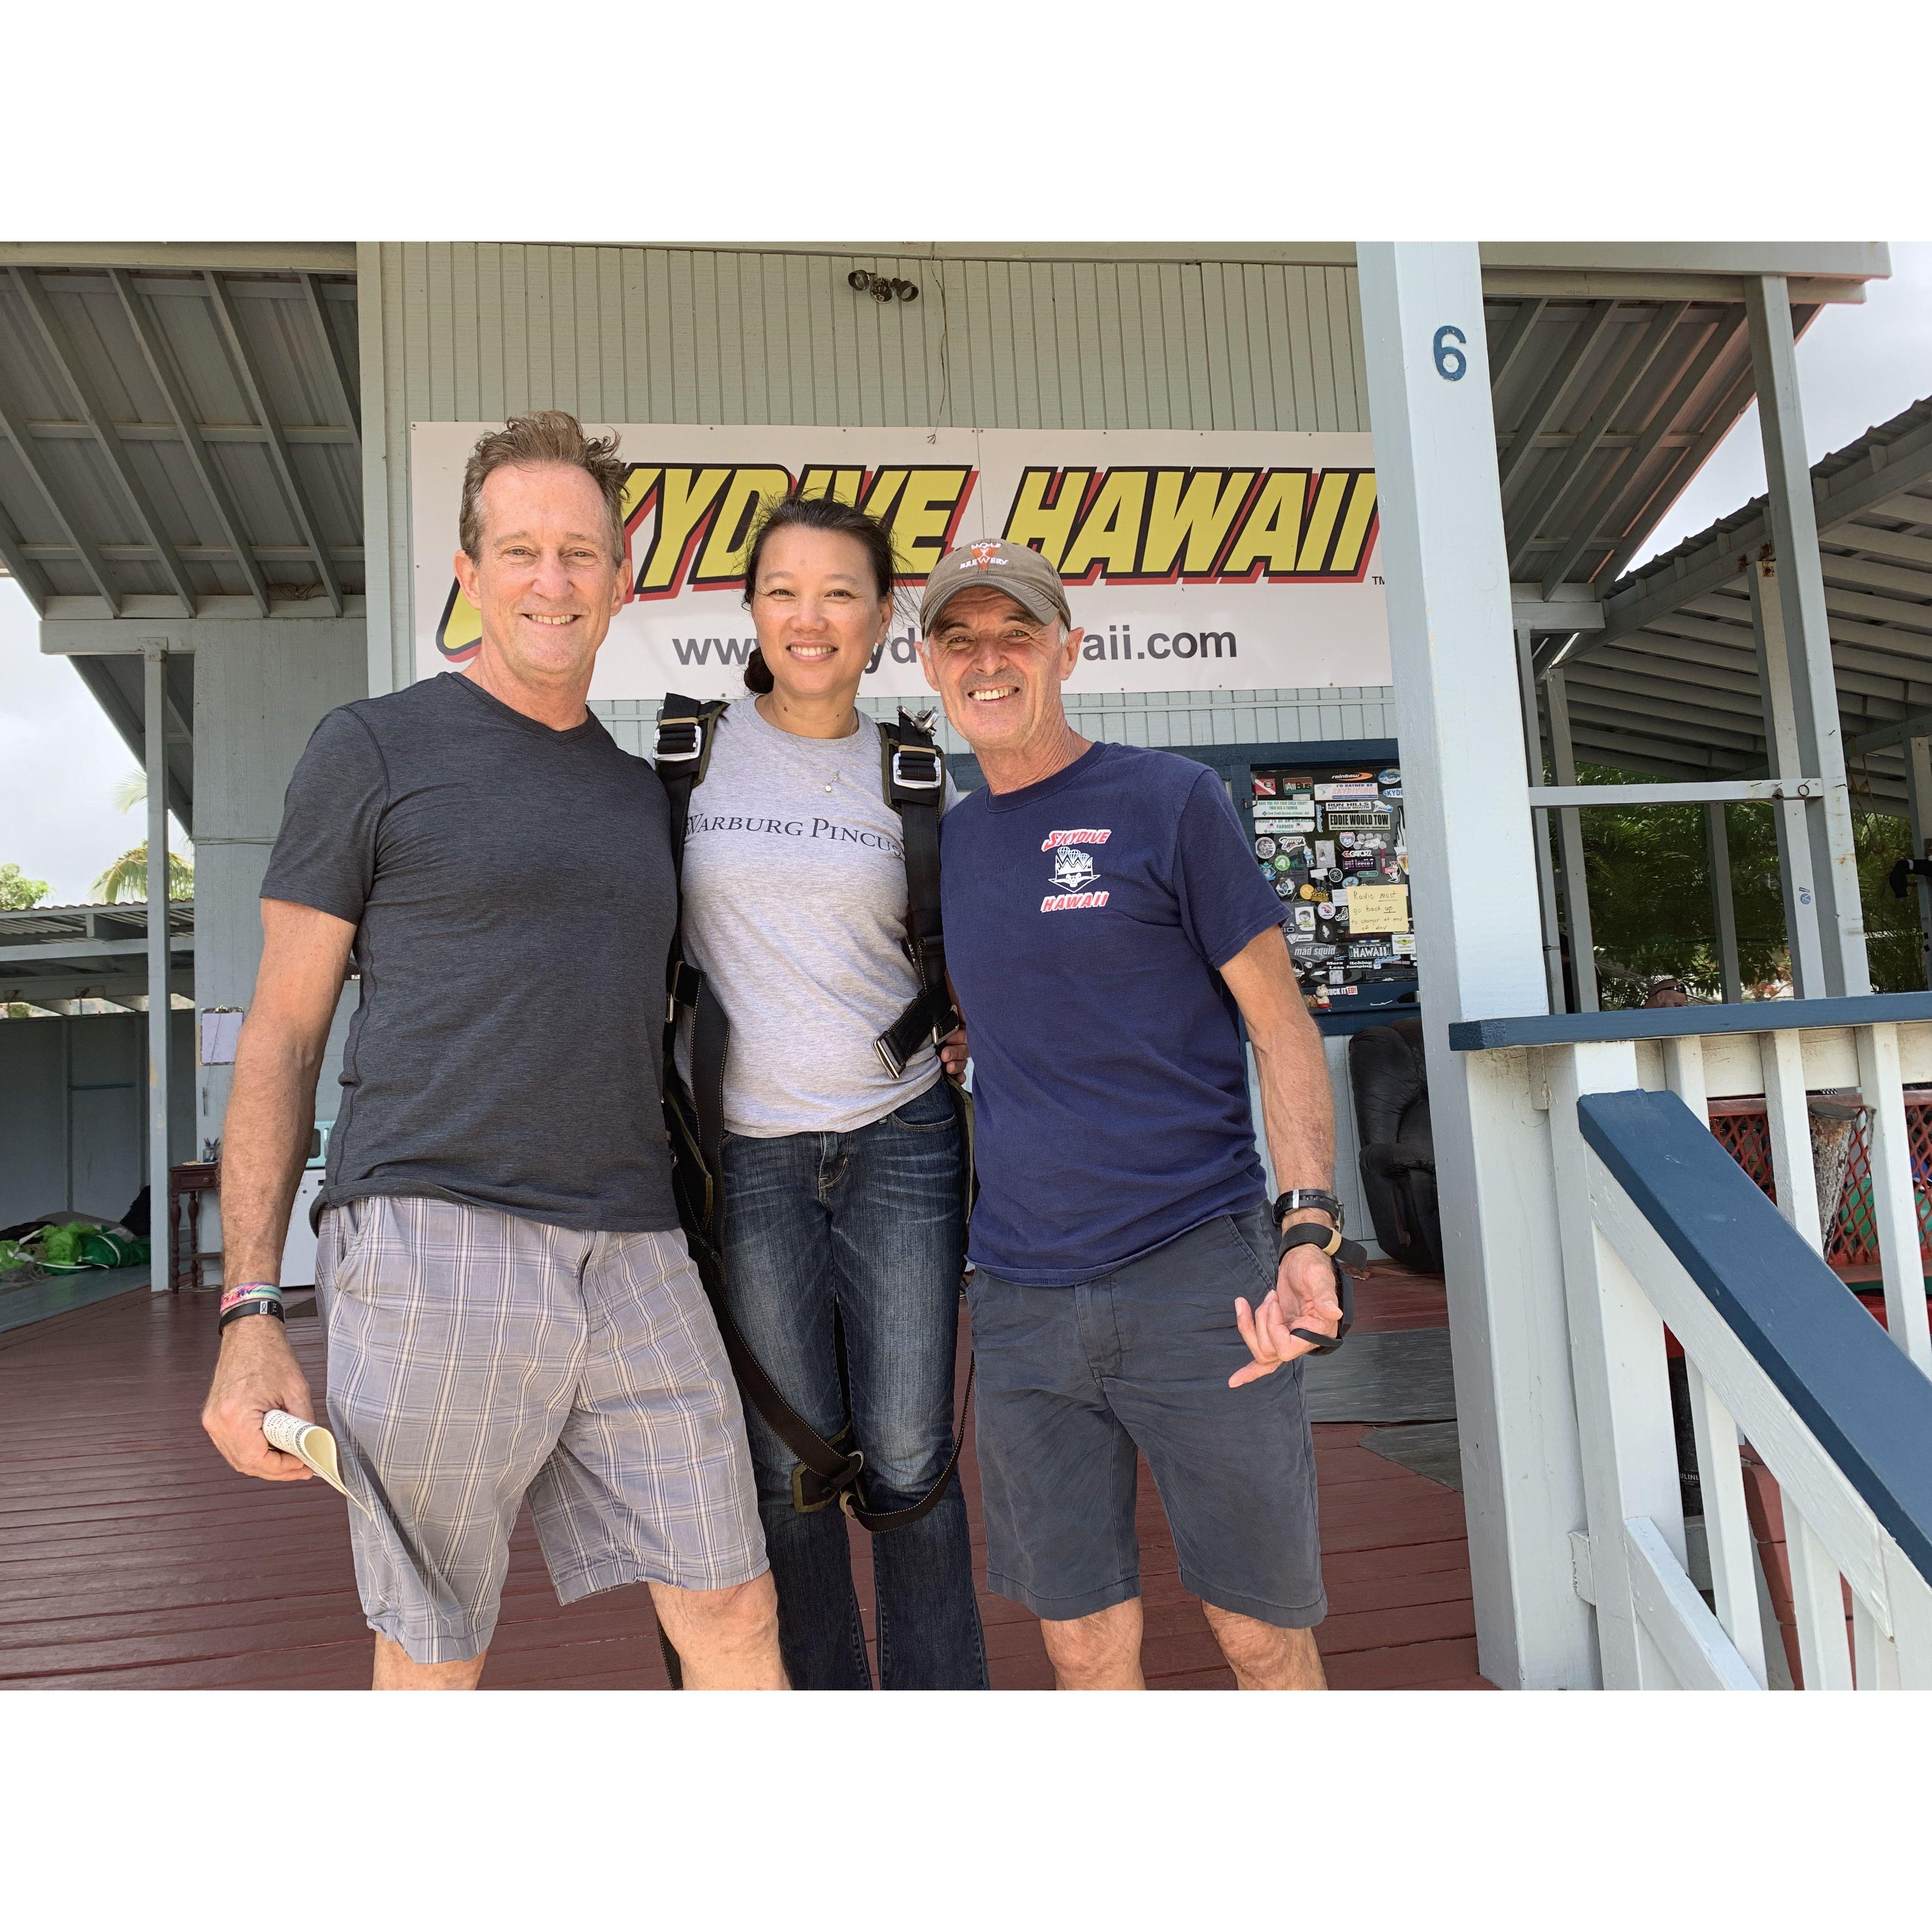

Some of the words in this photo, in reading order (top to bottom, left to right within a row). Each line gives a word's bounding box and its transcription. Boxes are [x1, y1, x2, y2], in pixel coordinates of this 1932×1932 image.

[1433, 325, 1466, 381] 6
[1001, 466, 1380, 585] HAWAII
[959, 557, 1009, 569] BREWERY
[1330, 815, 1349, 825] EDDIE
[1349, 815, 1373, 825] WOULD
[1374, 814, 1388, 825] TOW
[686, 814, 803, 837] WARBURG
[810, 817, 902, 857] PINCUS
[1041, 829, 1112, 852] SKYDIVE
[1040, 891, 1109, 913] HAWAII
[1354, 891, 1374, 899] Radio
[1295, 947, 1311, 955] mad
[1314, 946, 1335, 956] squid
[1353, 946, 1387, 957] HAWAII
